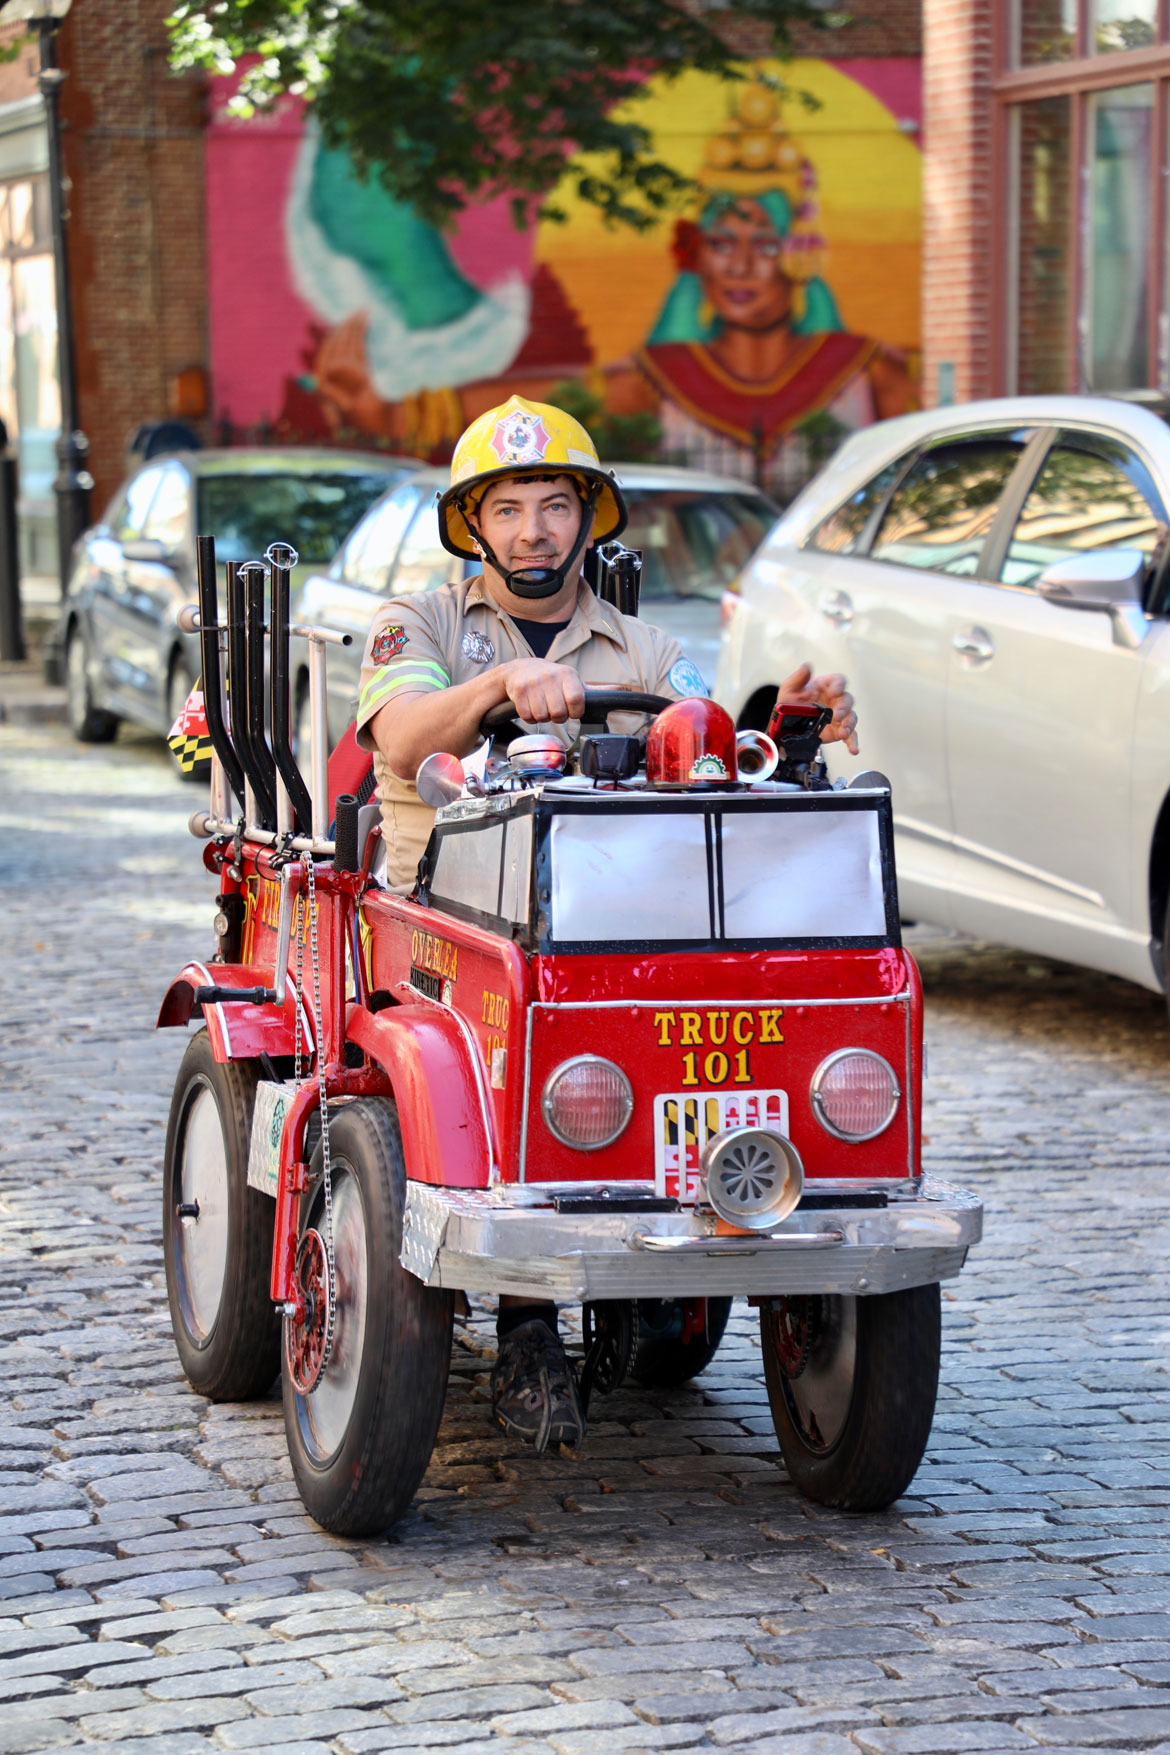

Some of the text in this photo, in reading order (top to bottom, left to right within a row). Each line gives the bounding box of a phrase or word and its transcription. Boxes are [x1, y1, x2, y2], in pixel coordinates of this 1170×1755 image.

[262, 879, 281, 932] FIR
[411, 929, 458, 983] OVERLEA
[653, 1009, 784, 1046] TRUCK
[682, 1049, 753, 1086] 101
